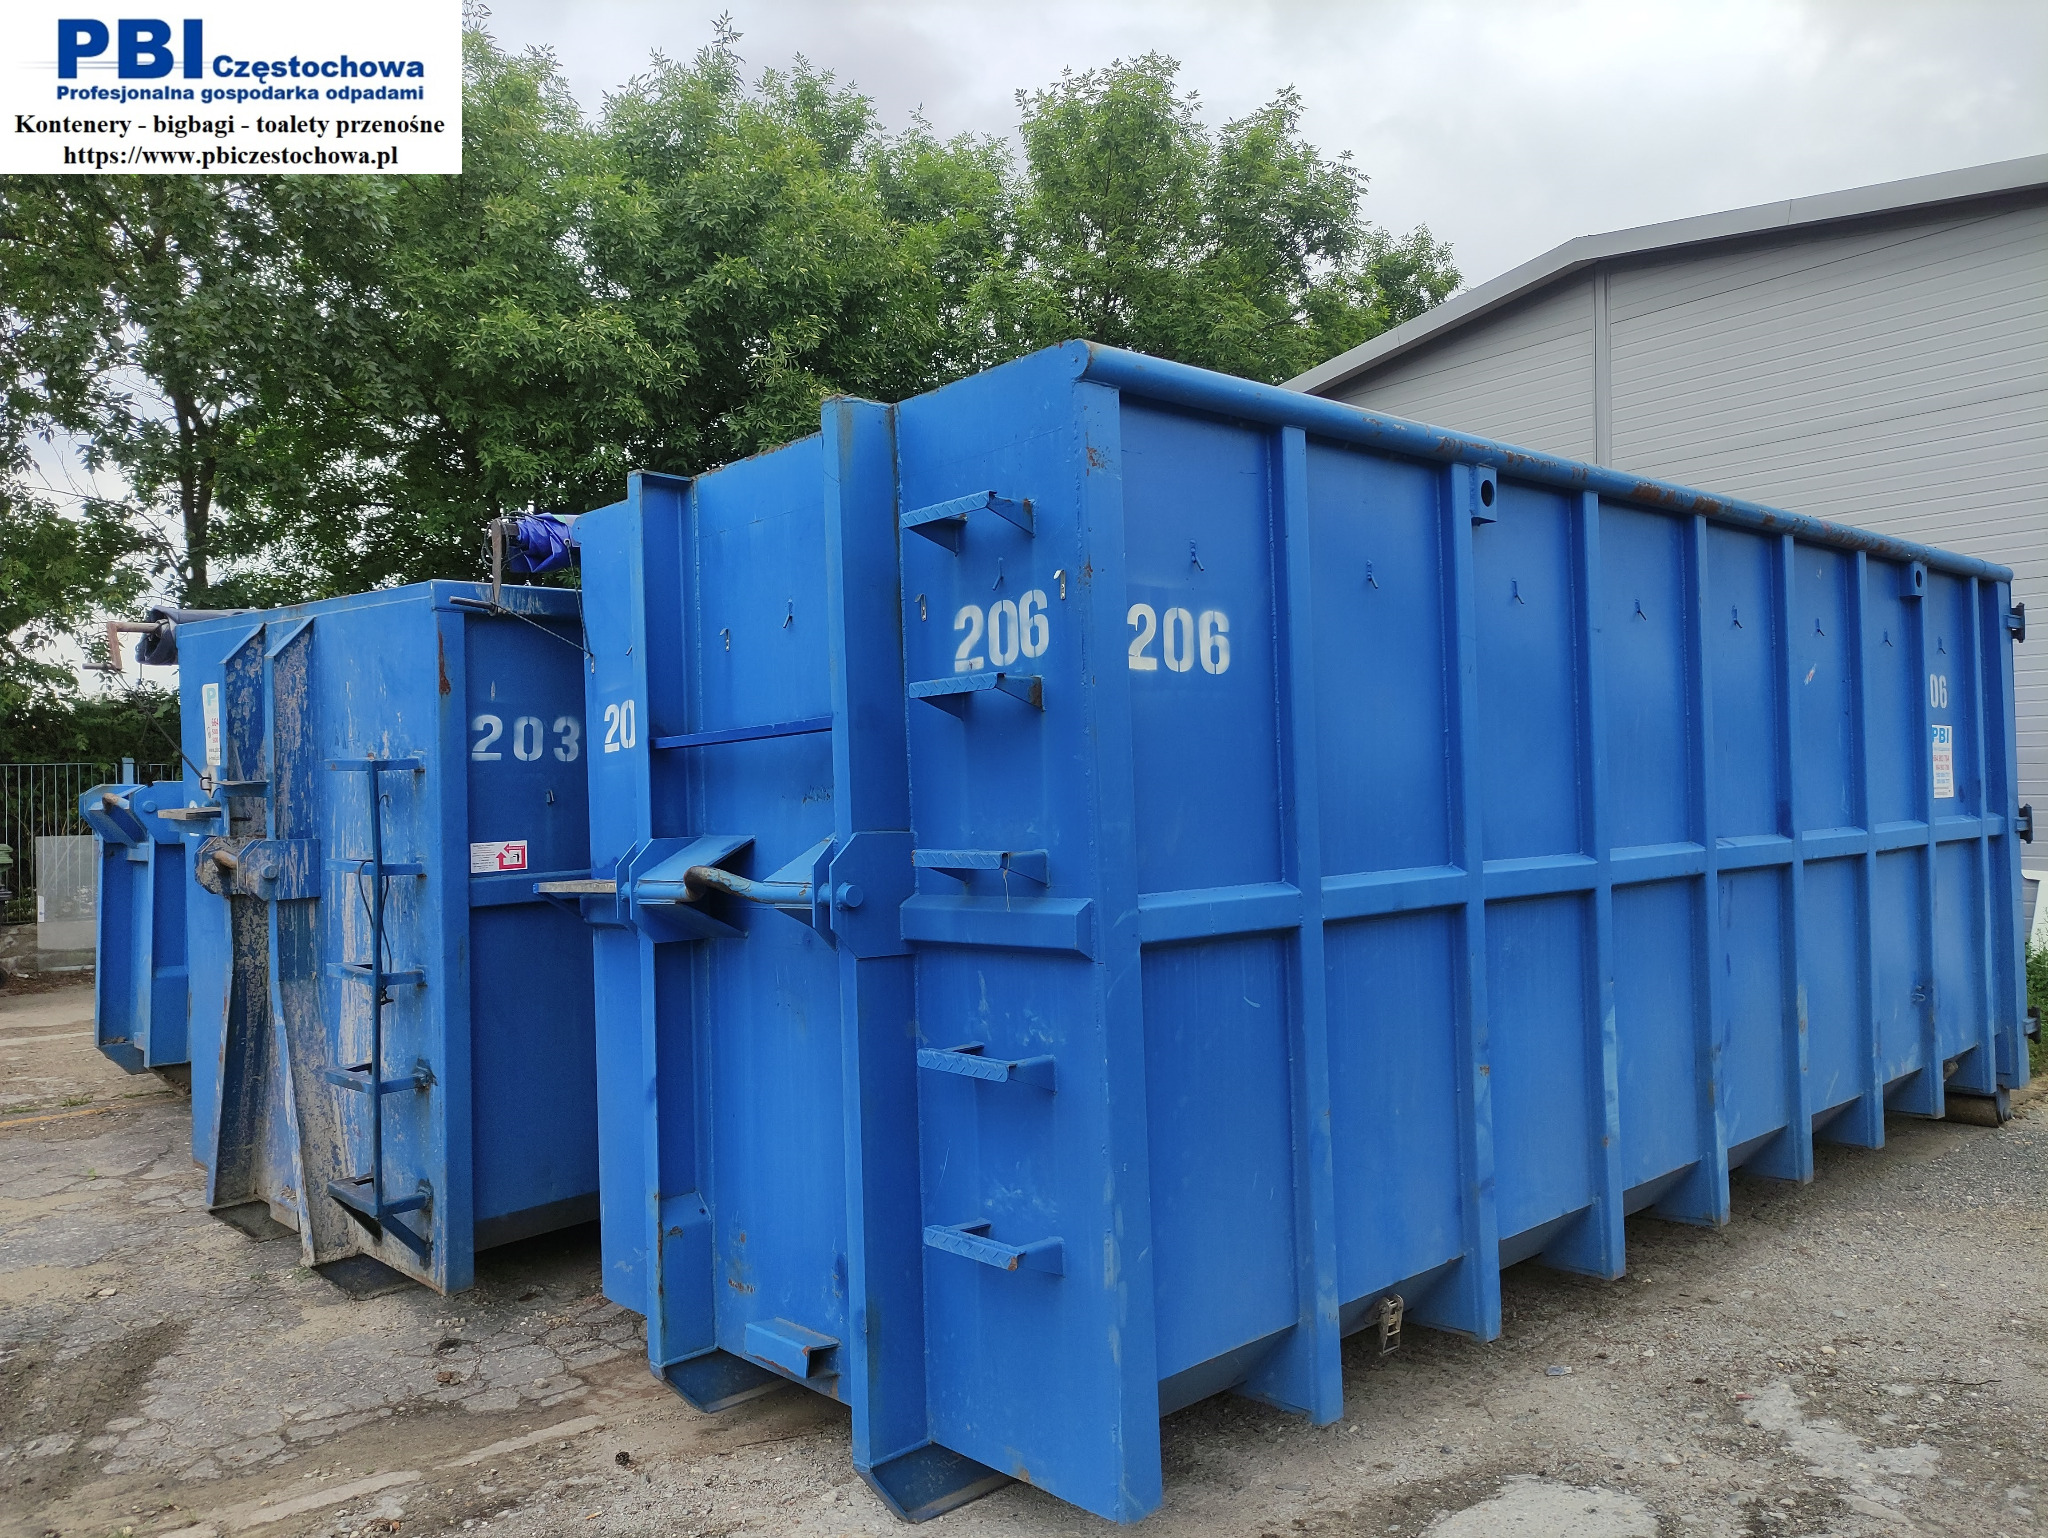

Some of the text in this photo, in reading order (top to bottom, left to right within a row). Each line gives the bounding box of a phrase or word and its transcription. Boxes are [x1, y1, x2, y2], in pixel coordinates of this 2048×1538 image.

[954, 590, 1050, 673] 206
[1126, 603, 1230, 675] 206
[1930, 673, 1948, 708] 06
[471, 713, 581, 763] 203
[603, 699, 636, 754] 20
[1932, 727, 1949, 744] PBI
